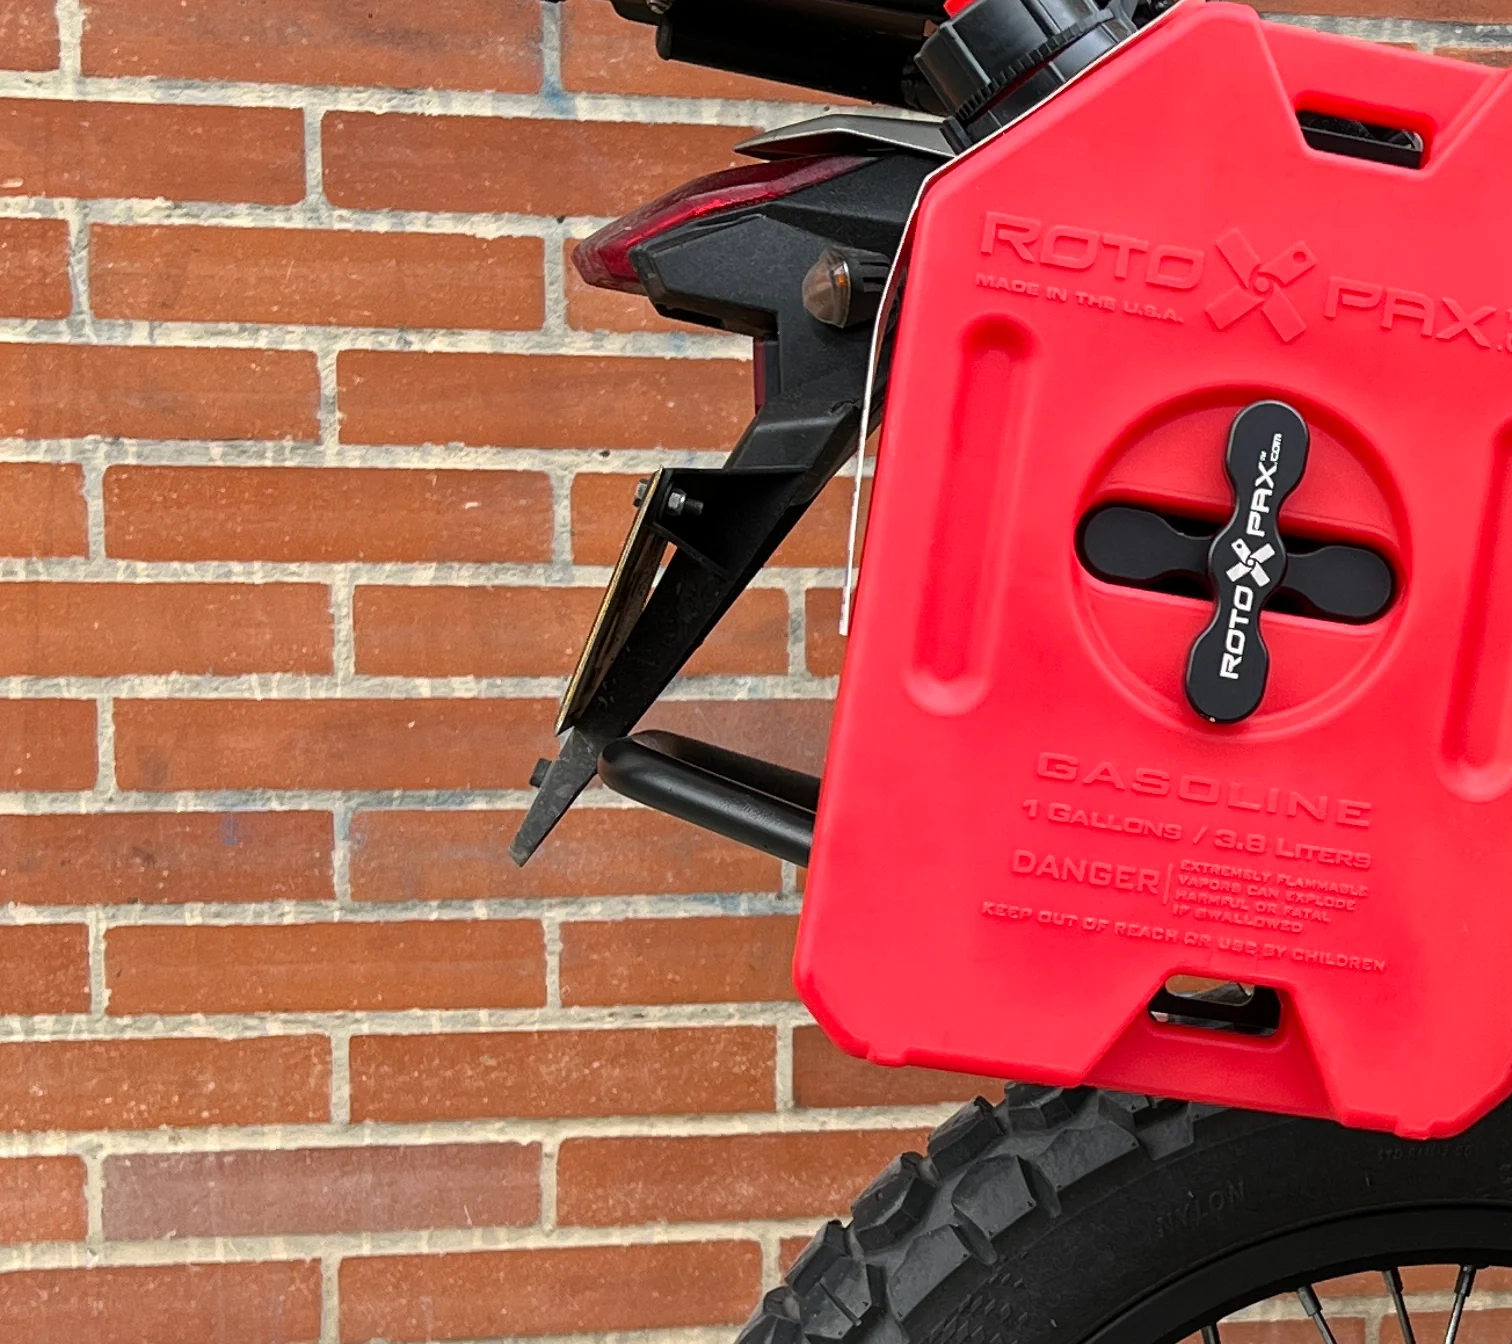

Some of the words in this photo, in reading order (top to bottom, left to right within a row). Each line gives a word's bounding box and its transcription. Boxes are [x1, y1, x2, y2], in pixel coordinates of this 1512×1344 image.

[980, 211, 1205, 290] ROTO
[975, 273, 1040, 297] MADE
[1046, 286, 1069, 303] IN
[1075, 291, 1117, 312] THE
[1123, 301, 1185, 325] U.S.A.
[1219, 585, 1255, 680] ROTO
[1036, 751, 1373, 828] GASOLINE
[1022, 799, 1040, 819] 1
[1048, 802, 1183, 841] GALLONS
[1214, 828, 1267, 854] 3.8
[1276, 837, 1372, 870] LITERS
[1012, 849, 1160, 895] DANGER
[1177, 874, 1242, 894] VAPORS
[1247, 885, 1280, 900] CAN
[1285, 891, 1357, 911] EXPLODE
[1179, 859, 1272, 884] EXTREMELY
[1276, 873, 1369, 898] FLAMMABLE
[1172, 903, 1191, 918] IF
[1195, 908, 1304, 934] SWALLOWED
[1175, 889, 1250, 911] HARMFUL
[1255, 901, 1277, 915] OR
[1283, 907, 1332, 924] FATAL
[981, 900, 1033, 920] KEEP
[1037, 910, 1079, 927] OUT
[1082, 916, 1110, 932] OF
[1114, 921, 1179, 944] REACH
[1218, 937, 1257, 955] USE
[1262, 943, 1288, 959] BY
[1292, 947, 1388, 972] CHILDREN
